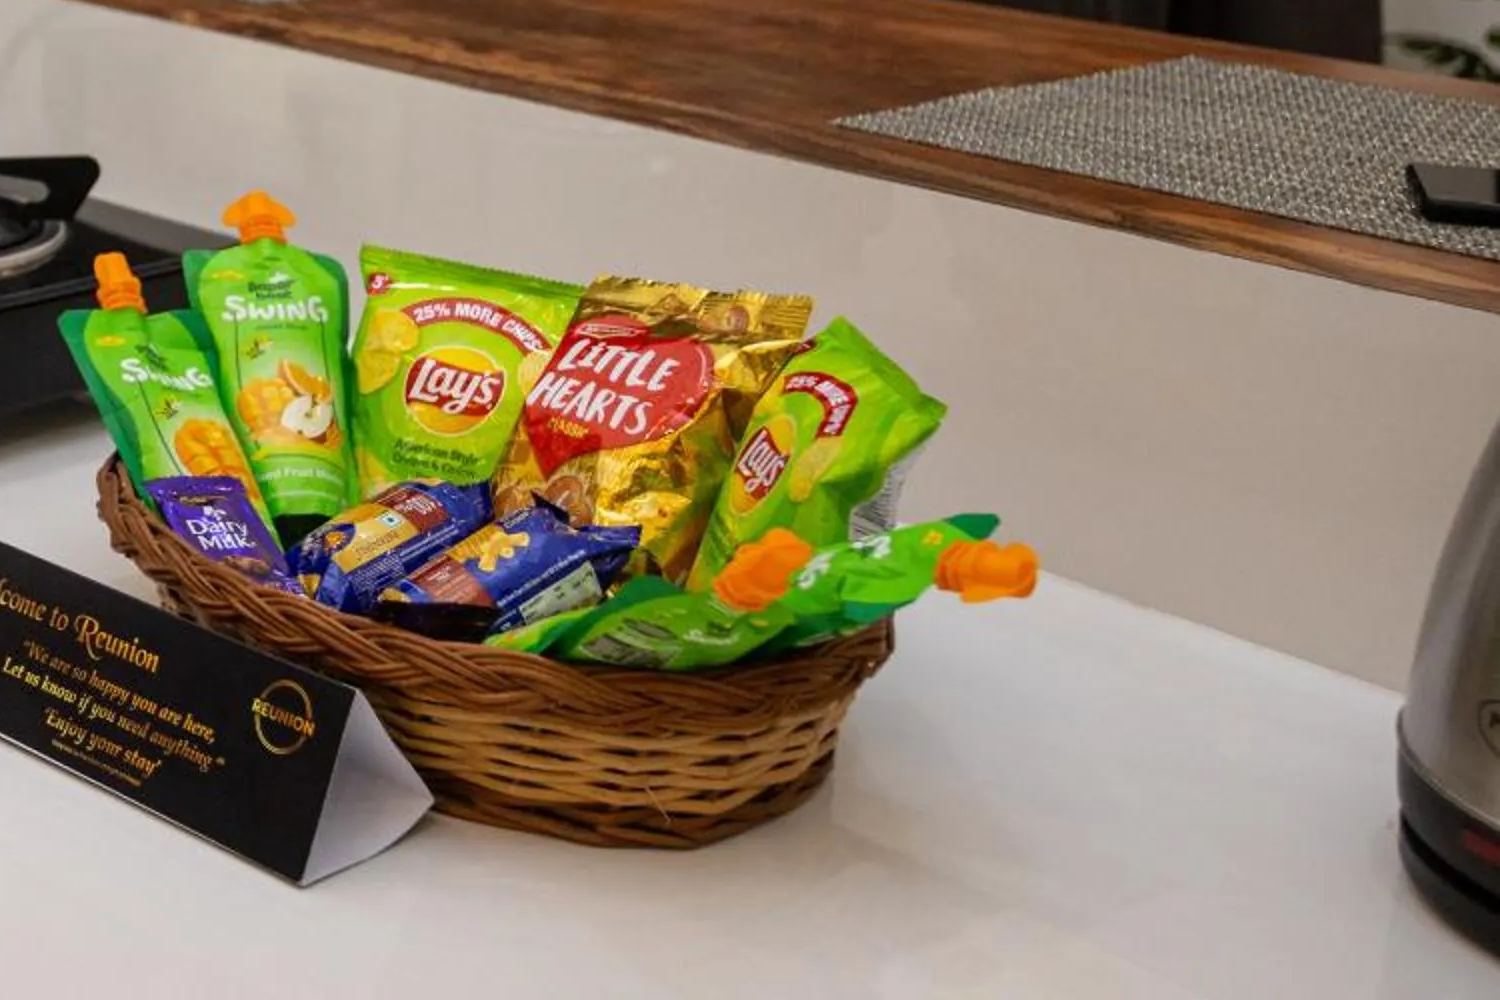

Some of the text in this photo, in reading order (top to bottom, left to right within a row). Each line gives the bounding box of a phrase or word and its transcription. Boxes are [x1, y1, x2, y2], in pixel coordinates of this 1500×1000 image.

[413, 303, 451, 322] 25%
[455, 302, 503, 328] MORE
[408, 357, 501, 414] Lay's
[557, 338, 681, 392] LITTLE
[526, 371, 653, 435] HEARTS
[185, 518, 248, 538] Dairy
[197, 533, 252, 552] Milk
[49, 606, 70, 632] to
[74, 613, 160, 674] Reunion
[3, 656, 25, 679] Let
[25, 671, 40, 687] us
[41, 675, 77, 703] know
[77, 693, 93, 714] if
[88, 703, 116, 723] you
[117, 715, 151, 739] need
[49, 656, 71, 675] are
[71, 666, 88, 680] so
[88, 669, 131, 705] happy
[129, 693, 158, 714] you
[158, 707, 182, 726] are
[251, 697, 316, 738] REUNION
[86, 733, 123, 757] your
